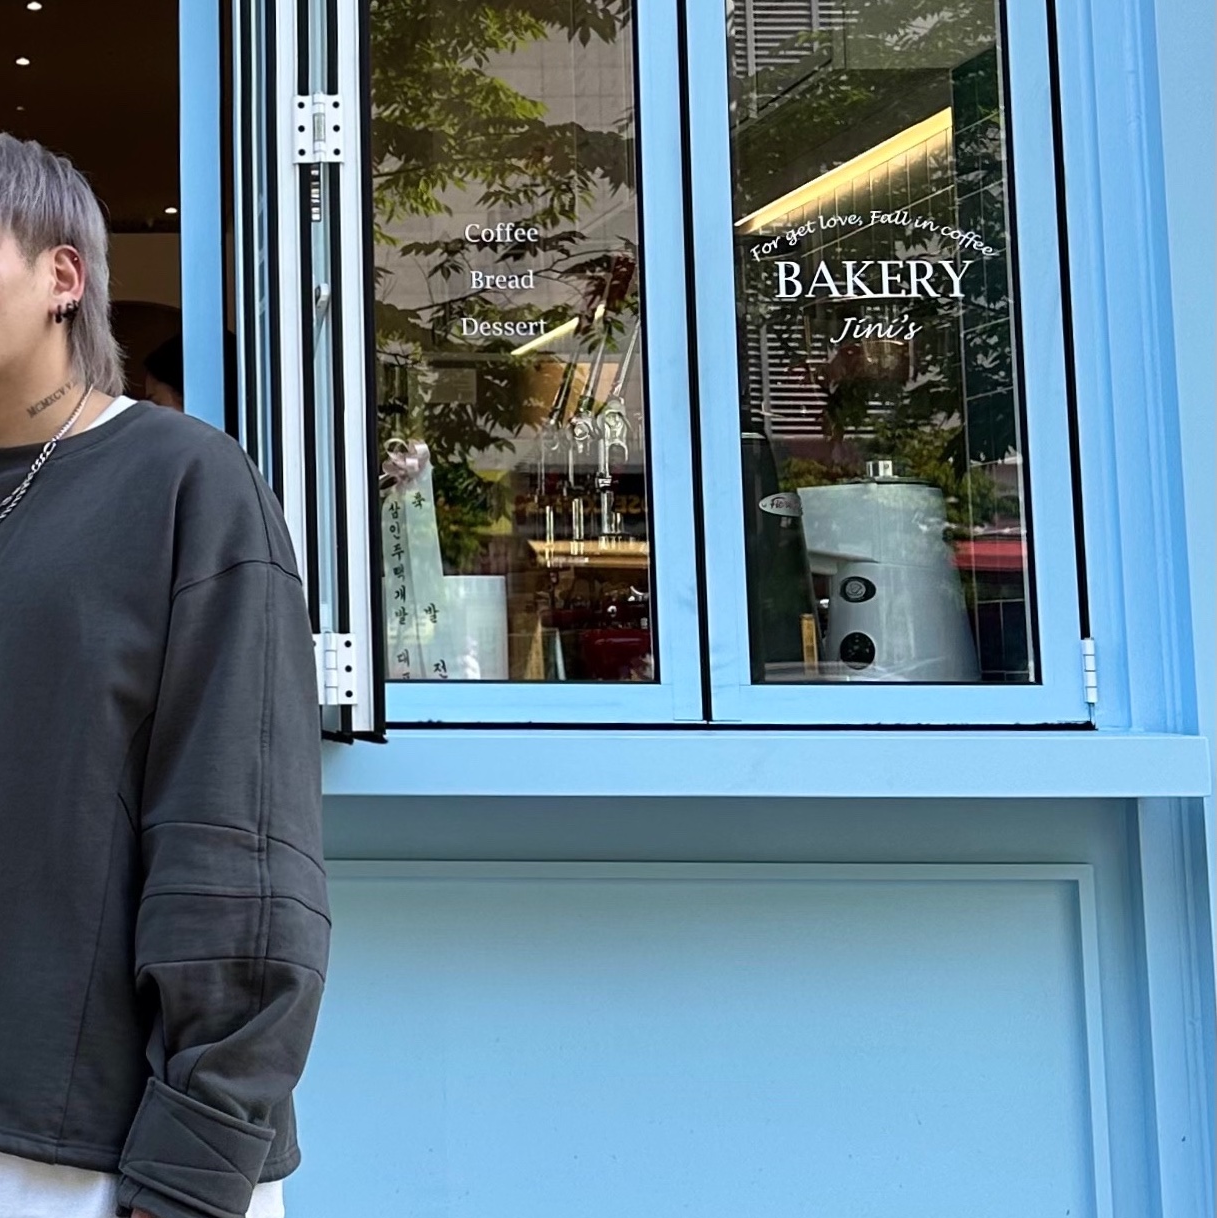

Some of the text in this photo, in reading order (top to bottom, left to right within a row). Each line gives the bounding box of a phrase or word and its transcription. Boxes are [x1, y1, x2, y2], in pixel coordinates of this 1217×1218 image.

[464, 222, 539, 243] Coffee
[750, 210, 997, 262] For get love, Fall in coffee
[470, 269, 535, 289] Bread
[775, 260, 974, 299] BAKERY
[461, 317, 547, 336] Dessert
[830, 314, 923, 344] Jini's
